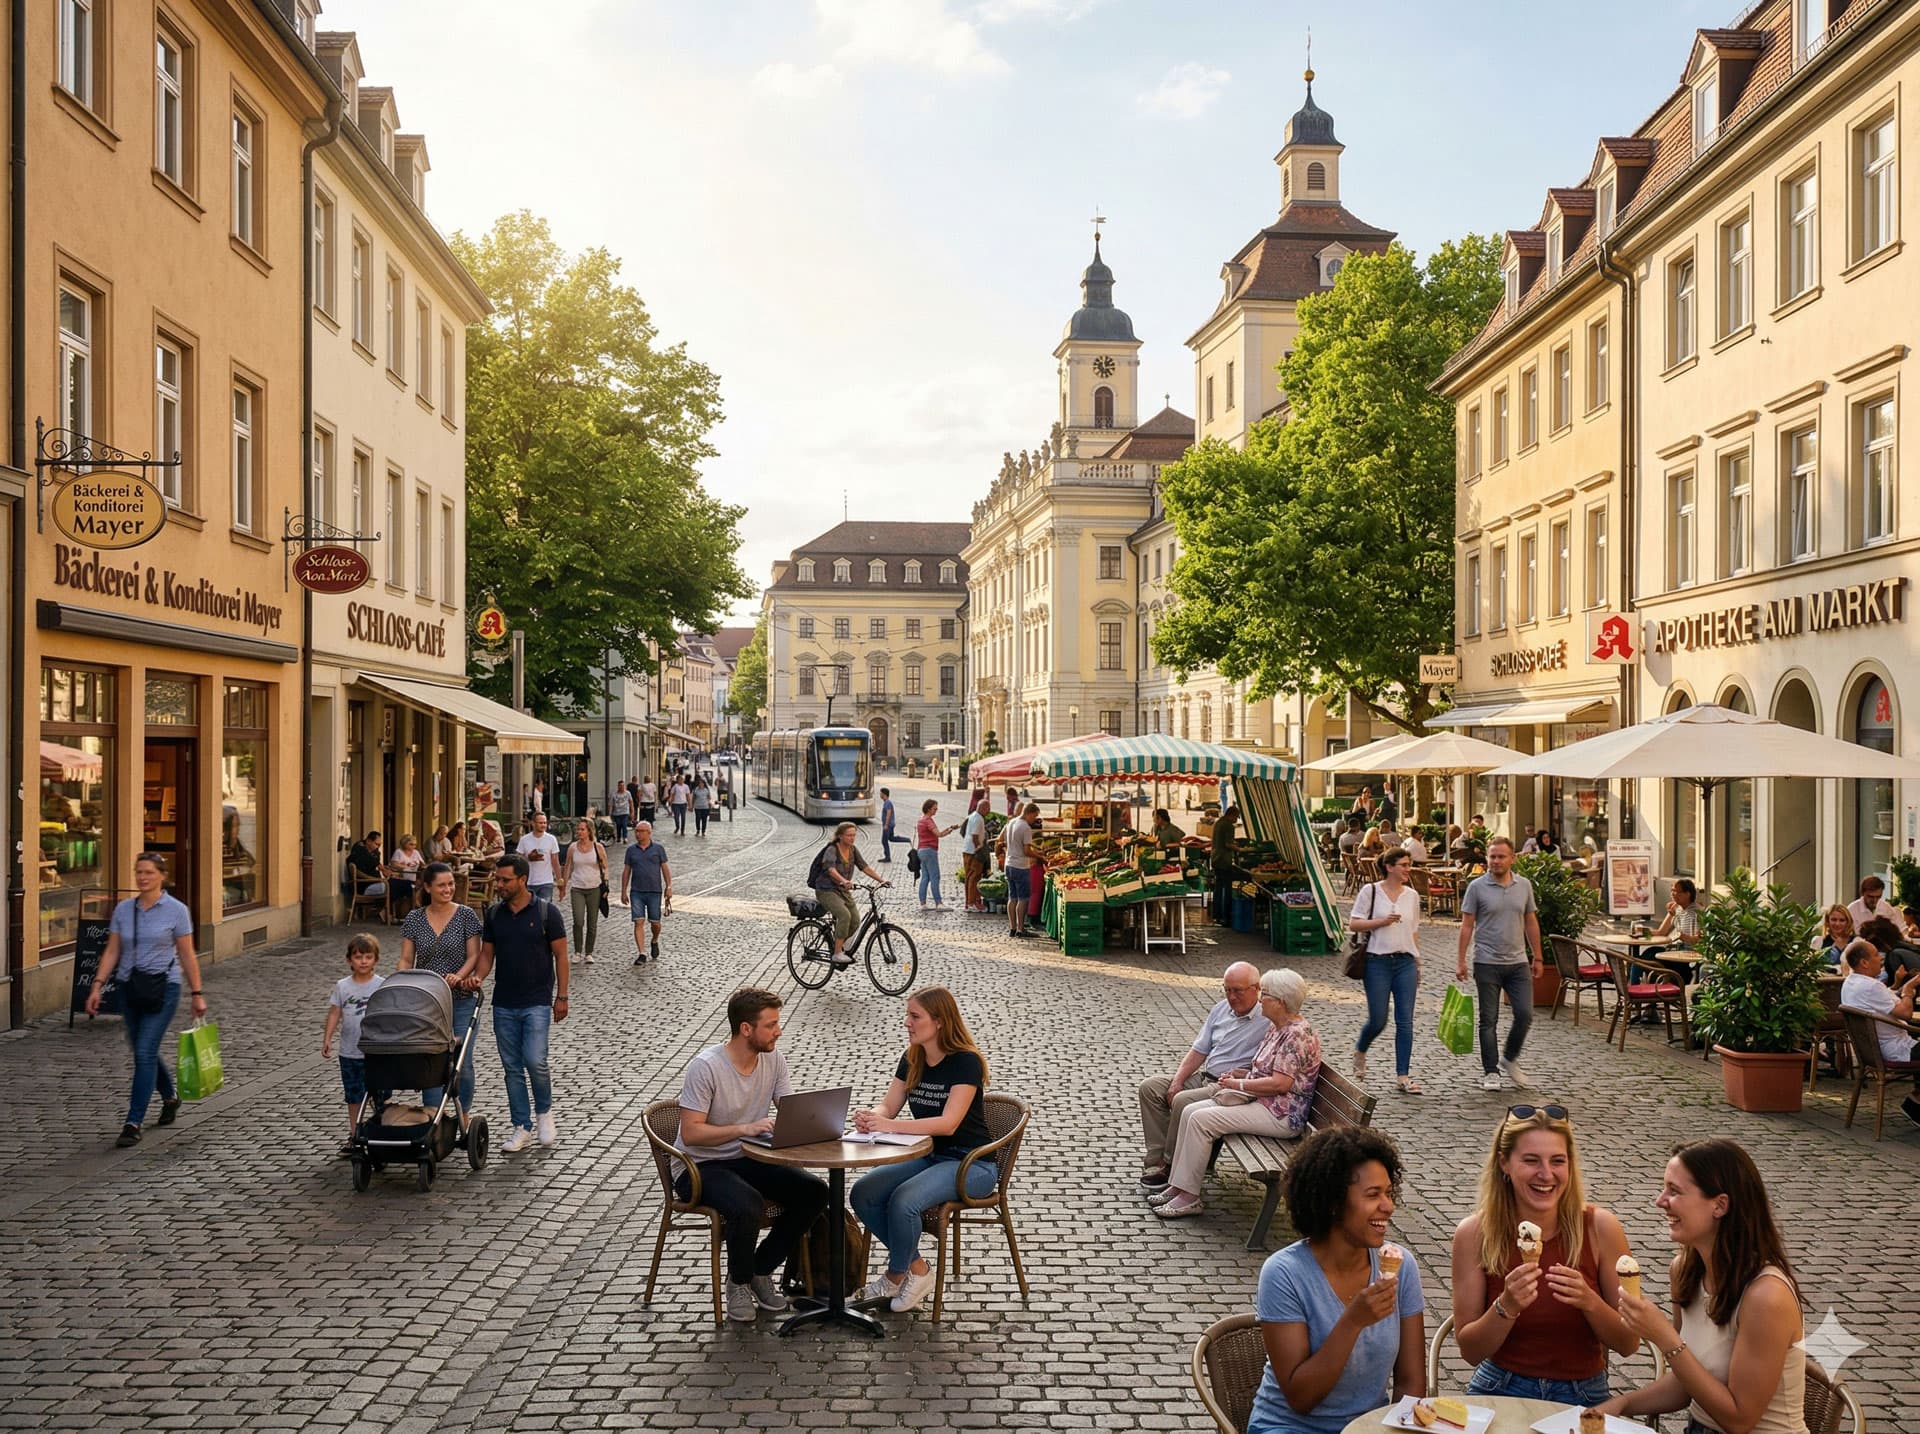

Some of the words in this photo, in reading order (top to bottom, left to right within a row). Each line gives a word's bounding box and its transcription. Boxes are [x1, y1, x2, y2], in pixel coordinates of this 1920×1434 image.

[73, 484, 130, 498] Bäckerei
[133, 484, 144, 498] &
[74, 499, 144, 513] Konditorei
[73, 515, 144, 541] Mayer
[54, 543, 140, 601] Bäckerei
[144, 566, 159, 605] &
[163, 570, 241, 622] Konditorei
[243, 591, 282, 637] Mayer
[1655, 604, 1759, 653] APOTHEKE
[1763, 596, 1803, 638] AM
[1807, 577, 1908, 632] MARKT
[347, 601, 446, 658] SCHLOSS-CAFÉ
[1423, 664, 1456, 681] Mayer
